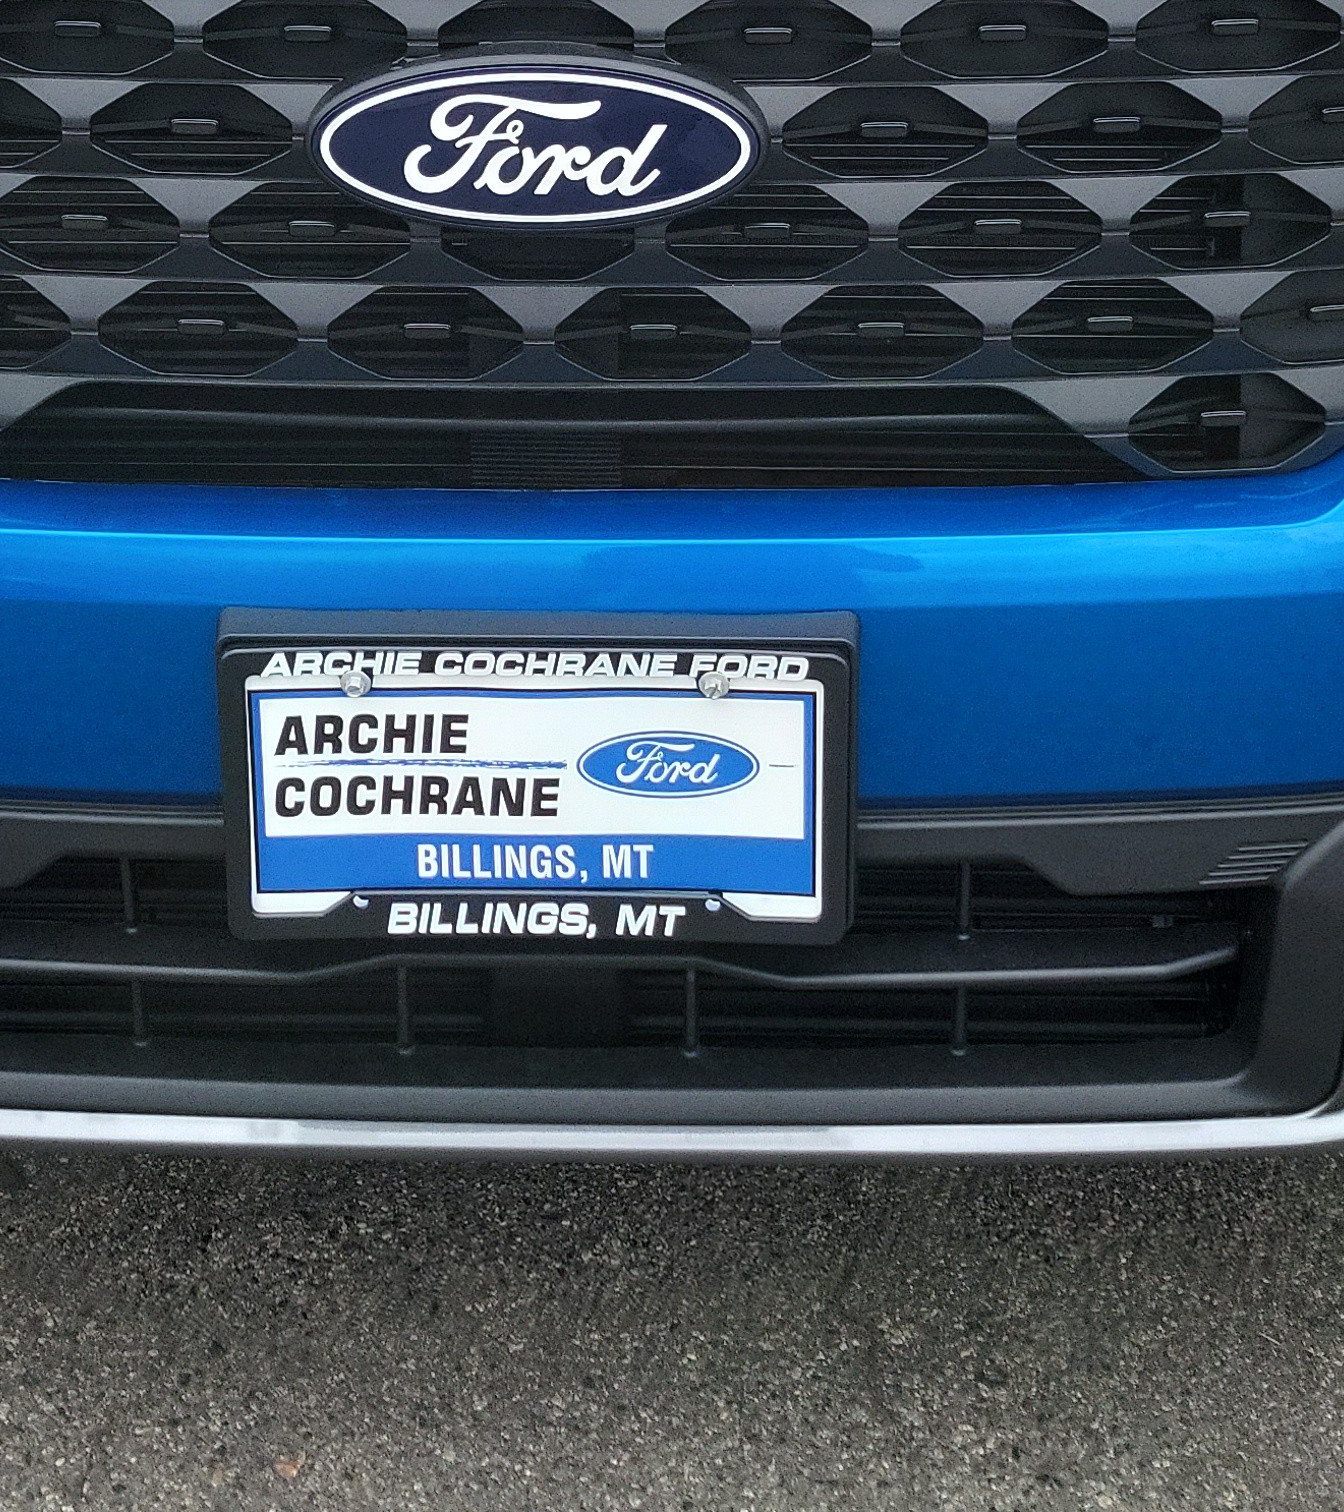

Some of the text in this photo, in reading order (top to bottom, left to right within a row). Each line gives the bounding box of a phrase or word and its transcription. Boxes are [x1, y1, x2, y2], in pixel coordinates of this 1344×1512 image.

[403, 93, 668, 197] Ford
[261, 651, 810, 681] ARCHIE COCHRANE FORD
[274, 713, 469, 756] ARCHIE
[615, 740, 721, 784] Ford
[274, 774, 560, 818] COCHRANE
[417, 843, 654, 884] BILLINGS, MT
[387, 902, 686, 939] BILLINGS, MT
